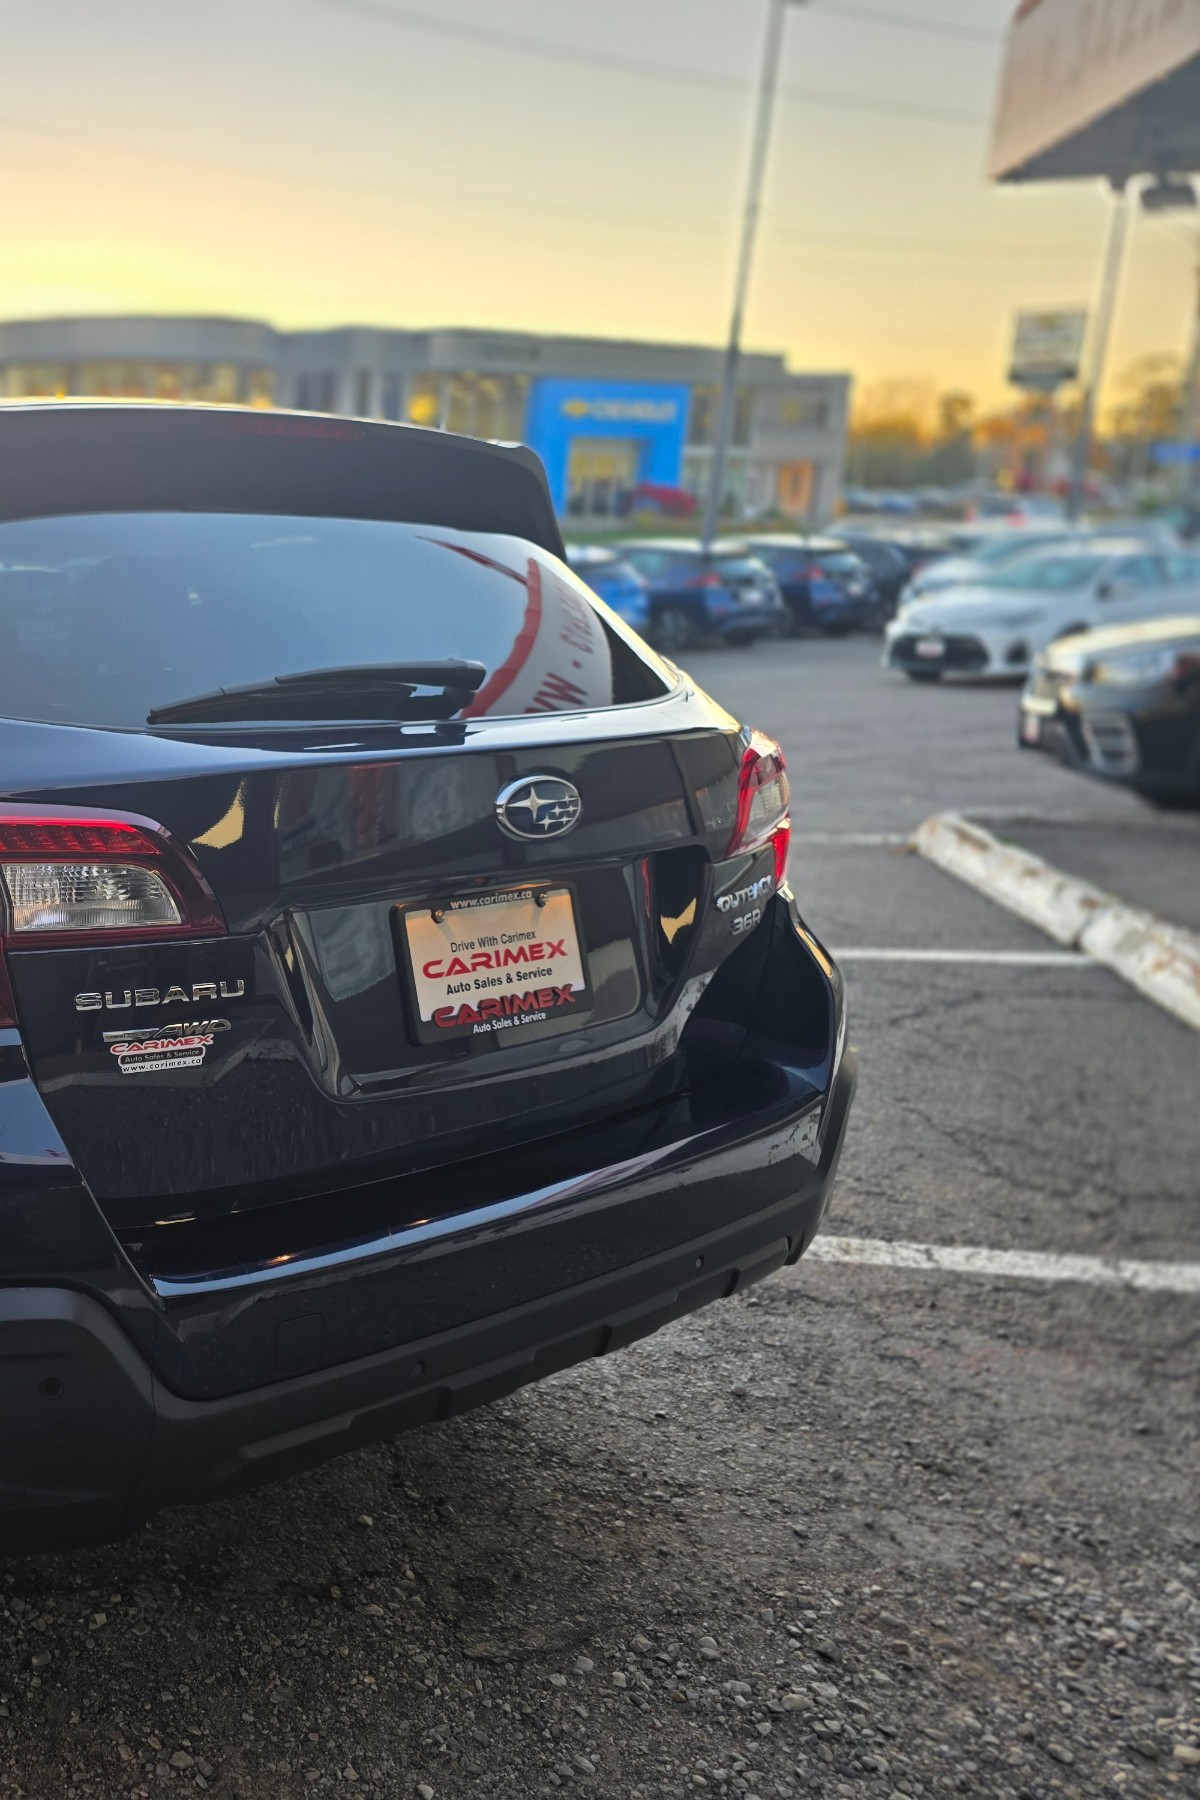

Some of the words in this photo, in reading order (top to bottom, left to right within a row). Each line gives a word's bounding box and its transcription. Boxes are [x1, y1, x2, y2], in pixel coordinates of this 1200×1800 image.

[450, 890, 532, 910] www.carimex.ca
[450, 941, 475, 953] Drive
[477, 936, 498, 949] With
[500, 931, 536, 945] Carimex
[422, 939, 568, 979] CARIMEX
[447, 981, 471, 996] Auto
[474, 975, 503, 990] Sales
[505, 973, 514, 984] &
[516, 966, 553, 982] Service
[75, 980, 245, 1011] SUBARU
[432, 983, 576, 1029] CARIMEX
[154, 1019, 232, 1037] AWD
[473, 1023, 491, 1034] Auto
[492, 1018, 512, 1030] Sales
[513, 1016, 520, 1024] &
[521, 1011, 547, 1023] Service
[111, 1034, 214, 1054] CARIMEX
[122, 1056, 201, 1073] www.carimex.ca
[125, 1055, 143, 1064] Auto
[144, 1052, 165, 1062] Sales
[174, 1048, 200, 1058] Service
